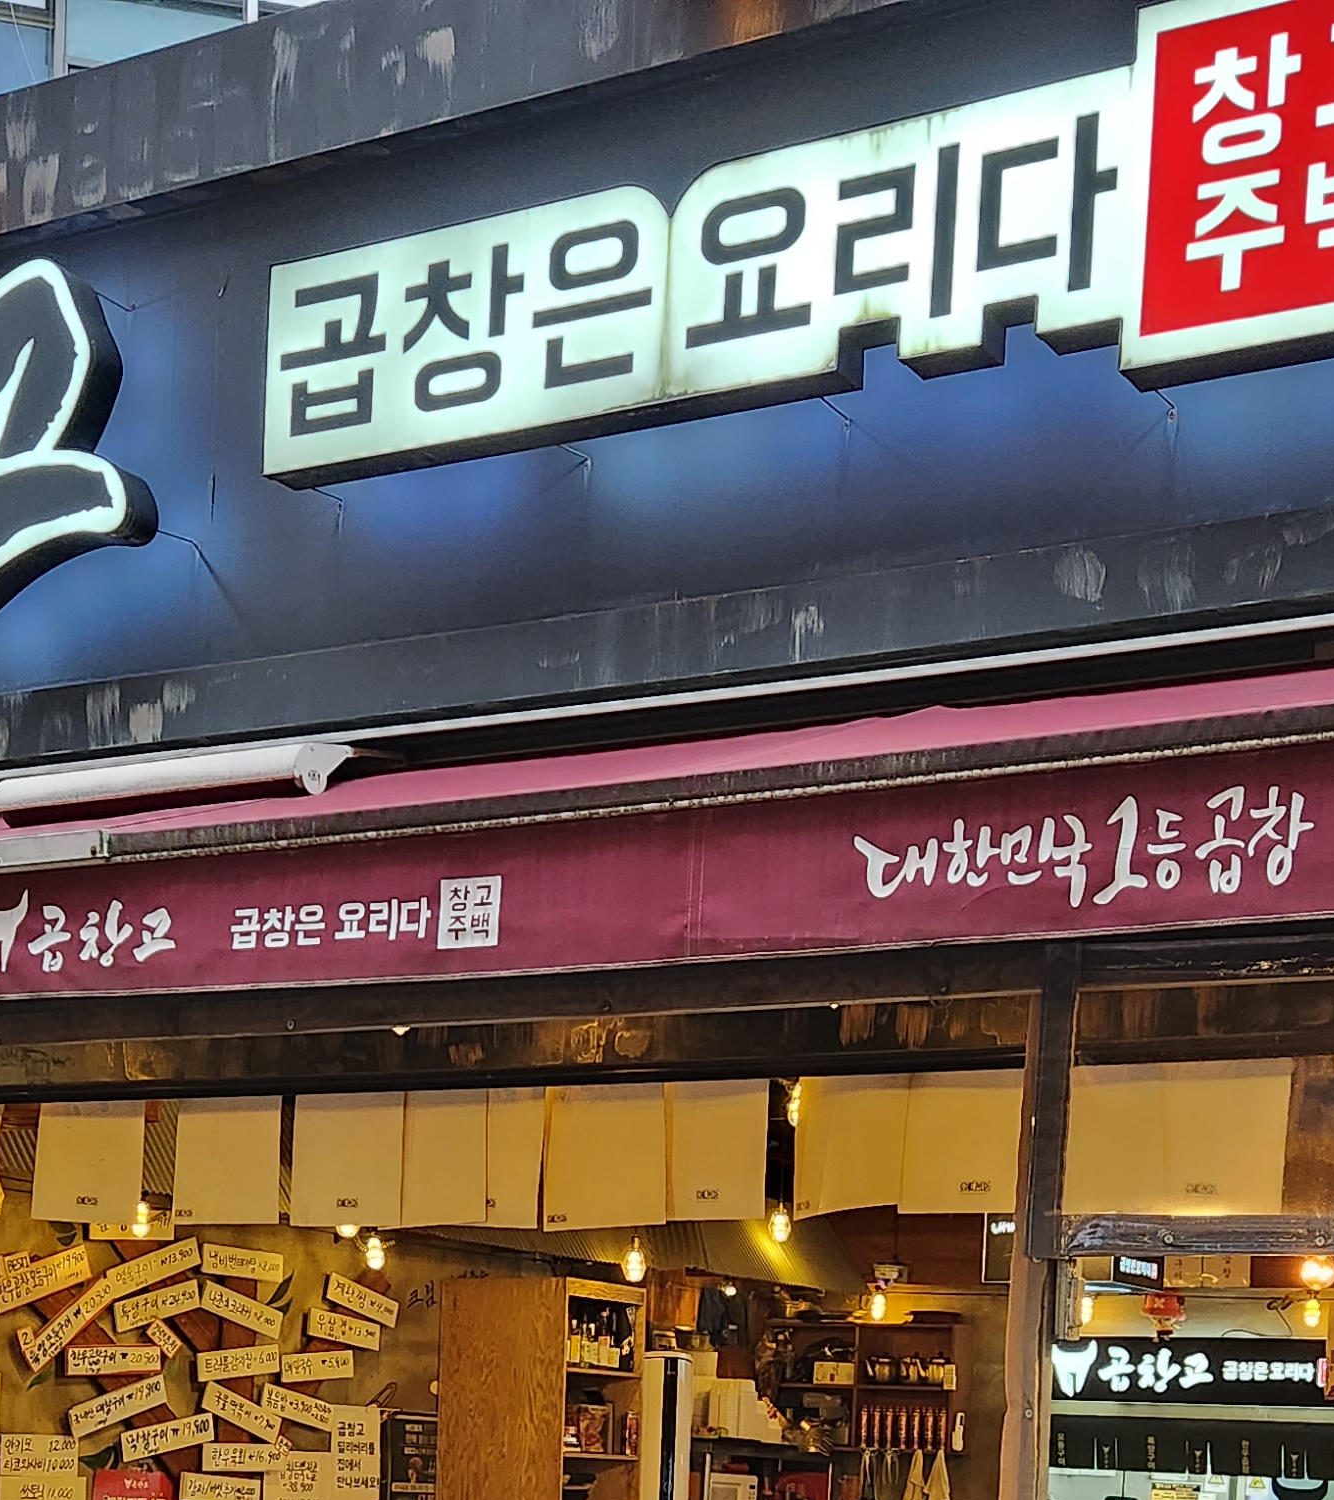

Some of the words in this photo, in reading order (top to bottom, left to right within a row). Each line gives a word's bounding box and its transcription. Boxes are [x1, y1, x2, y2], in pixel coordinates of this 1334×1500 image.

[278, 218, 655, 439] 곱창은
[684, 112, 1120, 350] 요리다
[449, 885, 494, 912] 창고
[28, 899, 176, 973] 곱창고
[230, 905, 325, 951] 곱창은
[334, 896, 432, 941] 요리다
[447, 912, 492, 940] 주백
[1097, 1345, 1215, 1394] 곱창고
